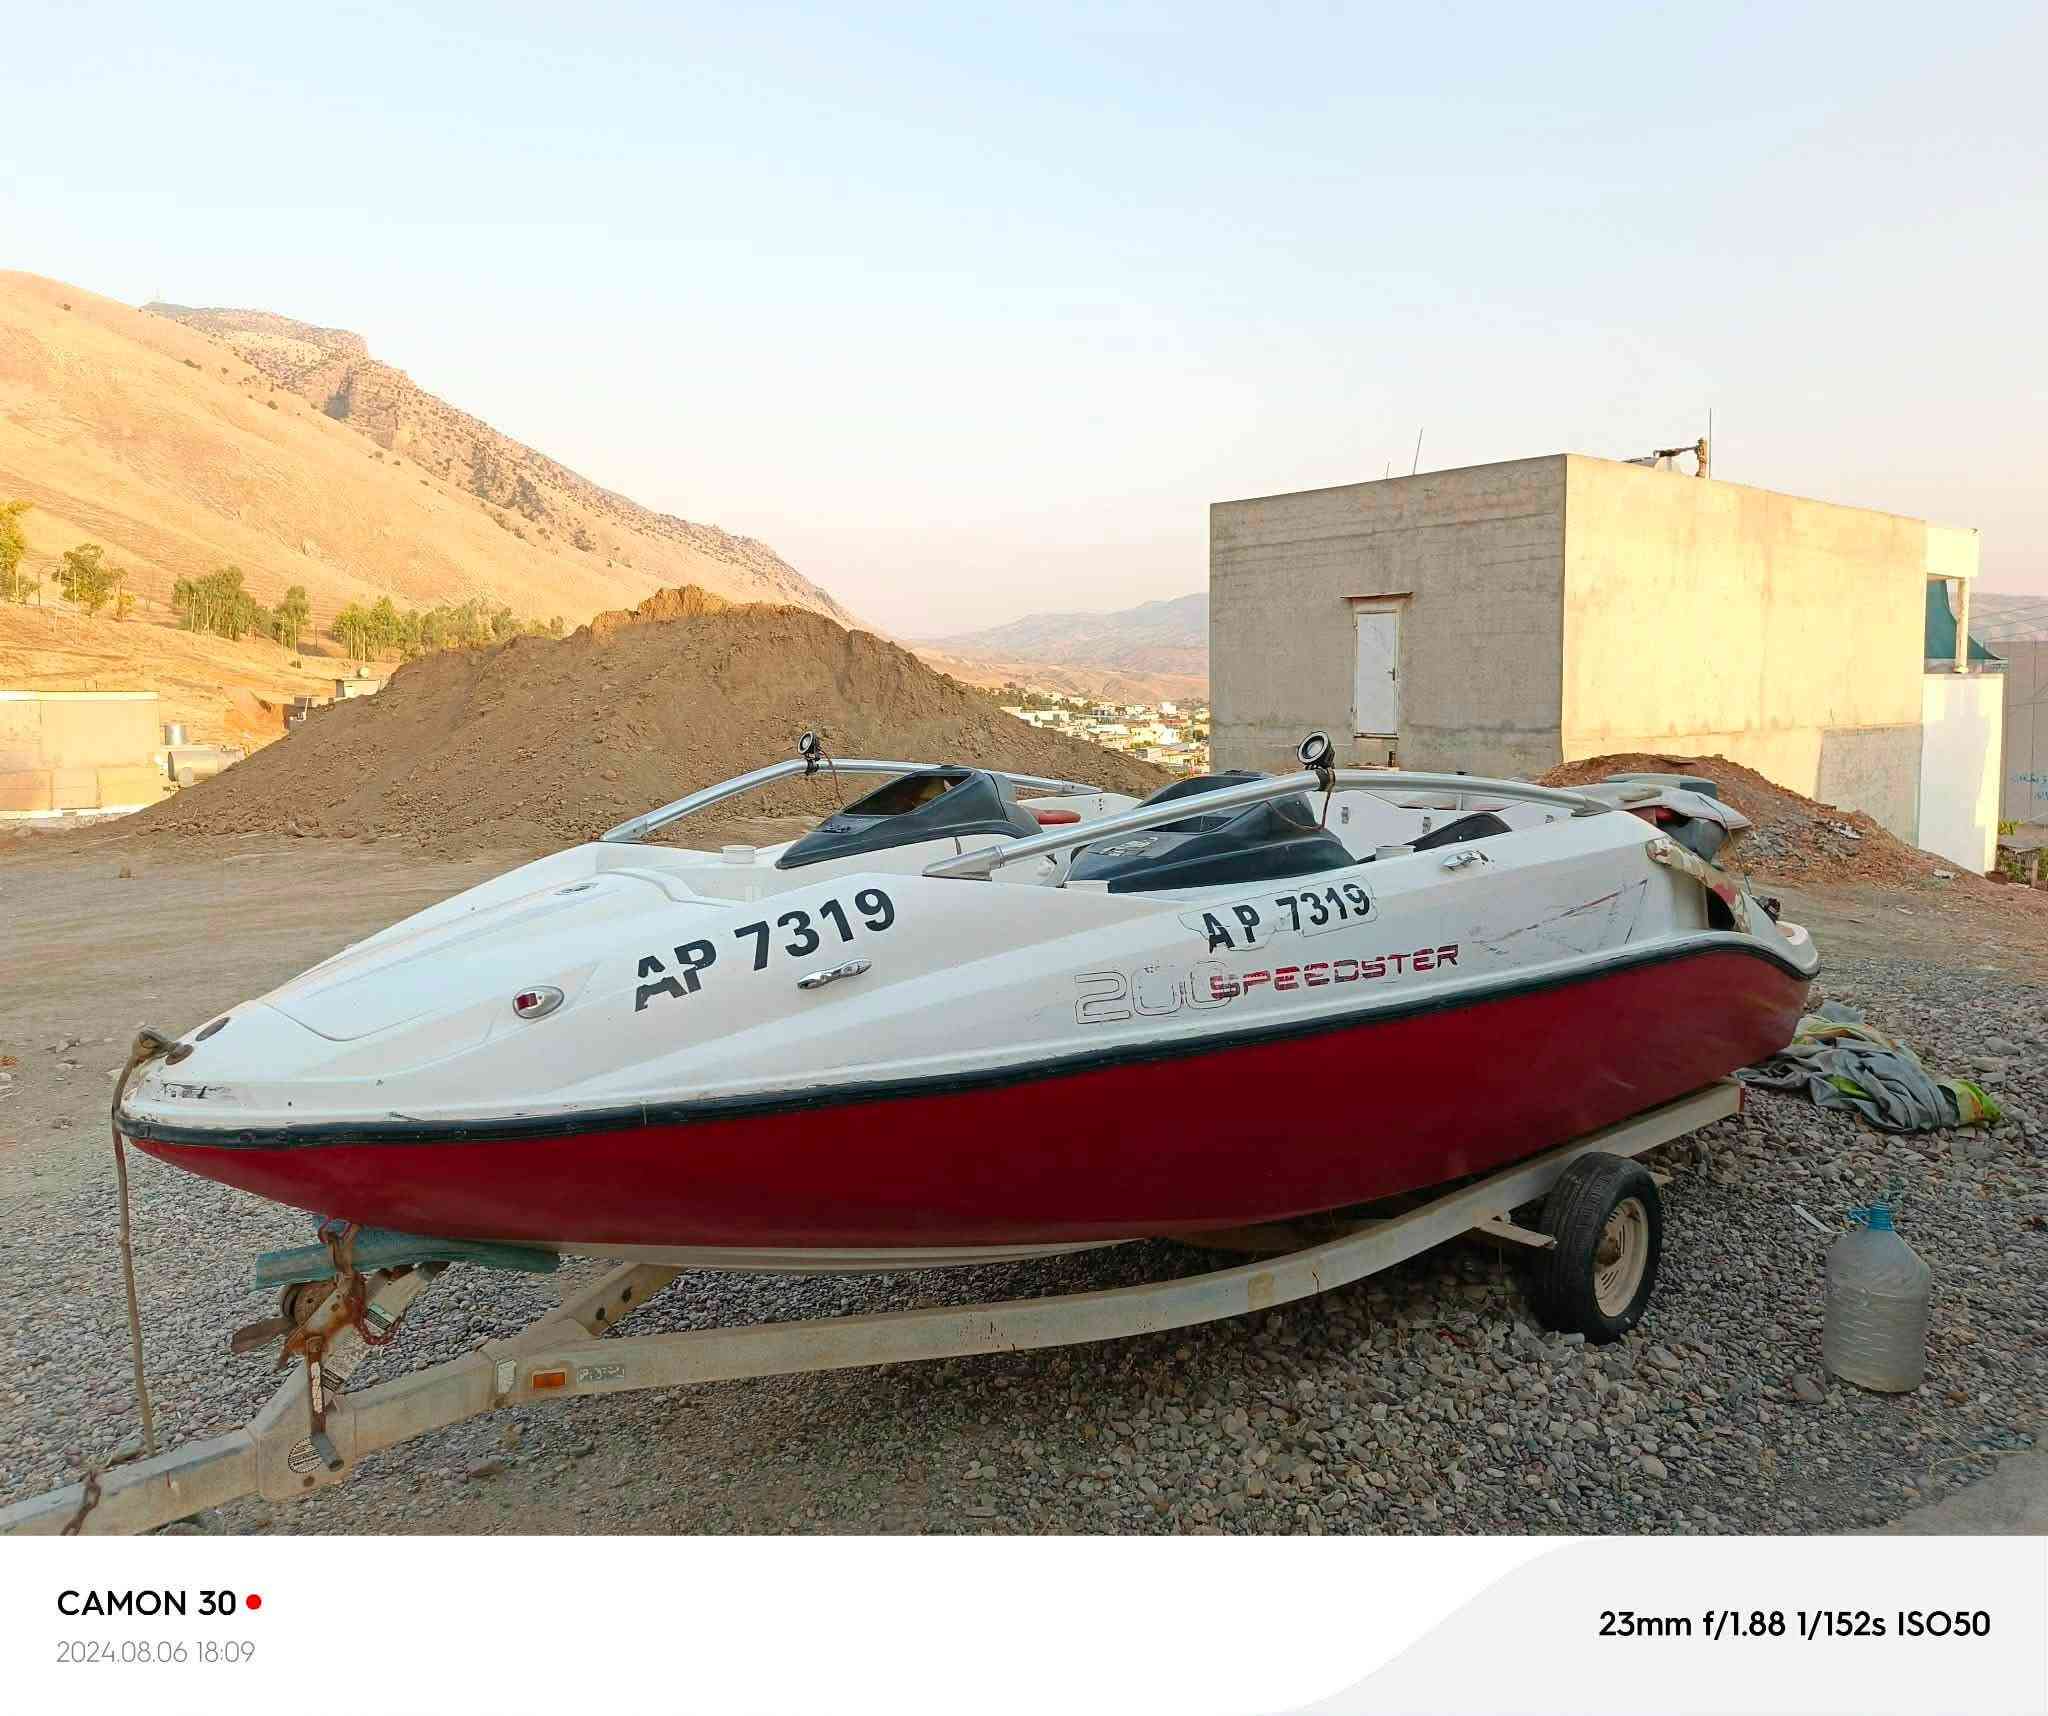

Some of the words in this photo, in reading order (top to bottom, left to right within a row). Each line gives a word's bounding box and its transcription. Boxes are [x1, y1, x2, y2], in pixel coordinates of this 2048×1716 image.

[635, 939, 717, 1013] AP
[733, 888, 896, 972] 7319
[1202, 904, 1261, 953] AP
[1274, 883, 1372, 932] 7319
[1209, 943, 1460, 1001] SPEEDSTER
